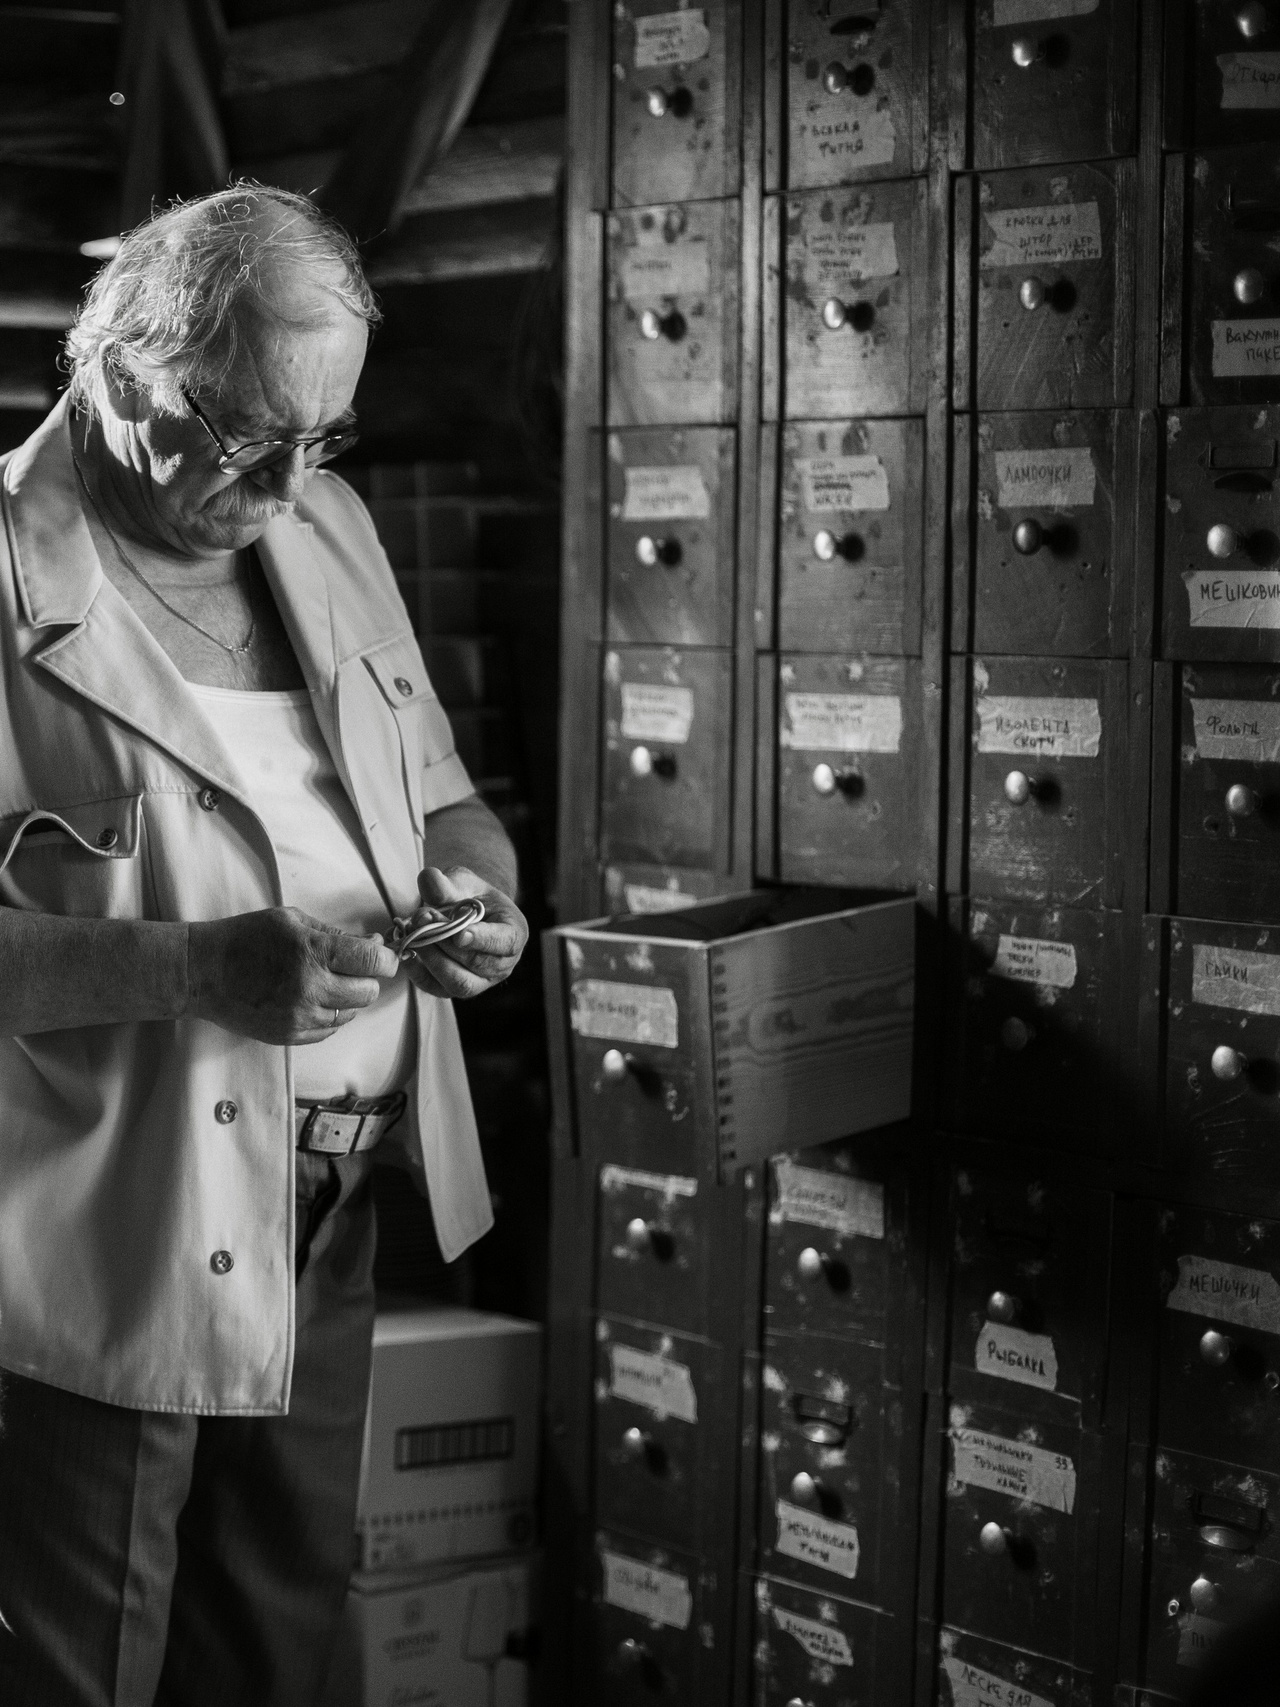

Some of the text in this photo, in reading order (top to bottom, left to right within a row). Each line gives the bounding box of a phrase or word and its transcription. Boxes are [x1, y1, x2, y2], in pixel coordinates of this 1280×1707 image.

[1005, 464, 1073, 485] ЛАМПОЧКИ
[995, 716, 1071, 735] ИЗОЛЕНТА
[1013, 735, 1056, 749] СКОТЧ
[1205, 961, 1248, 984] ГАЙКИ
[1189, 1274, 1261, 1306] МЕШОЧКИ
[987, 1339, 1047, 1376] РЫБАЛКА
